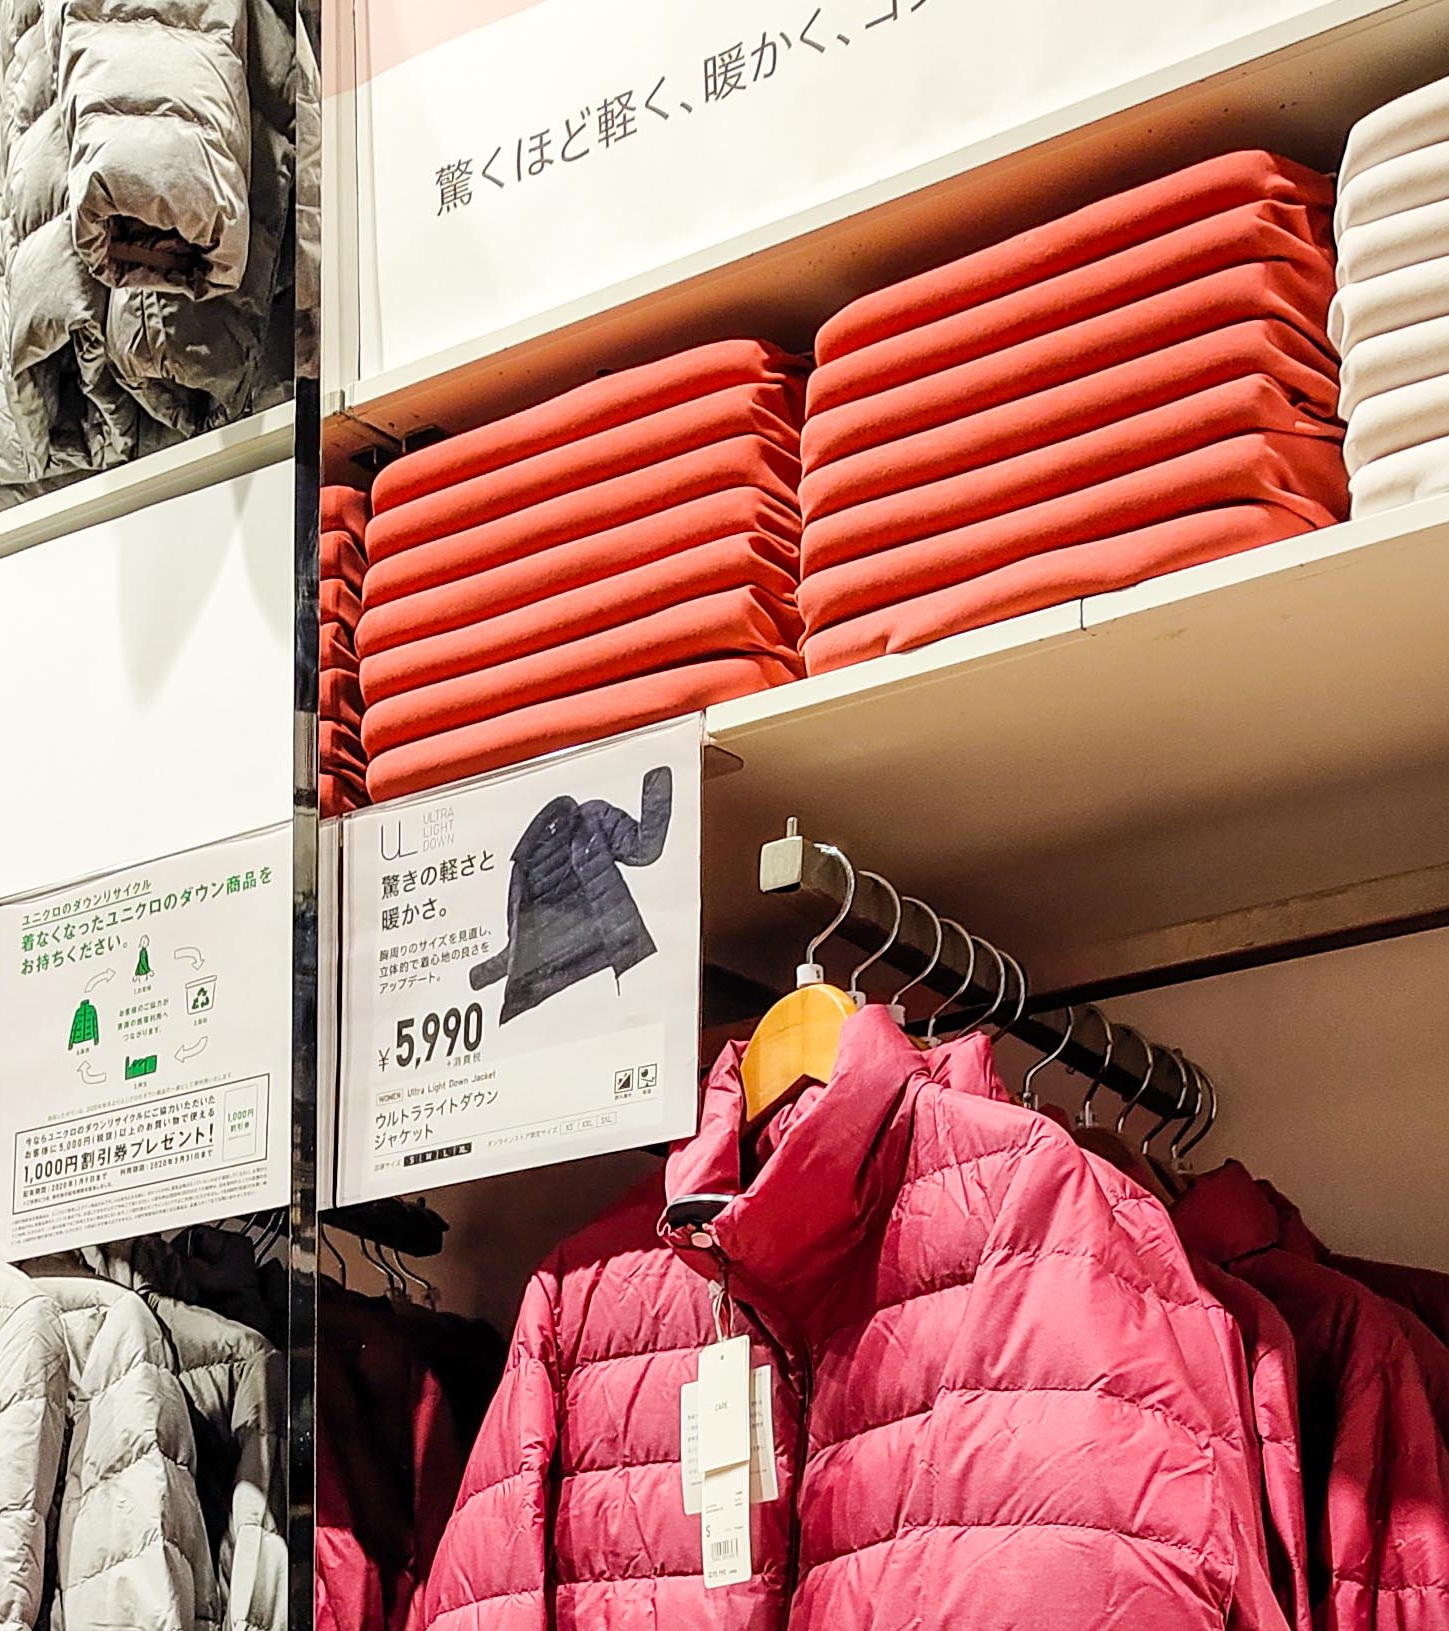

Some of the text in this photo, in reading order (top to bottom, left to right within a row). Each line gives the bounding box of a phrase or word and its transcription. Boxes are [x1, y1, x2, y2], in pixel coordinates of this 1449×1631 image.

[434, 0, 927, 217] 驚くほど軽く、暖かく、コ
[423, 807, 455, 824] ULTRA
[423, 819, 455, 838] LIGHT
[380, 820, 418, 861] UL
[423, 833, 455, 852] DOWN
[381, 850, 495, 900] 驚きの軽さと
[21, 866, 272, 952] 着なくなったユニクロのダウン商品を
[22, 879, 151, 926] ユニクロのダウンリサイクル
[381, 898, 447, 931] 暖かさ。
[21, 934, 128, 975] お持ちください。
[379, 942, 490, 978] 立体的で着心地の良さを
[407, 1086, 425, 1098] Ultra
[427, 1081, 446, 1094] Light
[449, 1077, 469, 1089] Down
[471, 1070, 496, 1083] Jacket
[375, 1091, 499, 1130] ウルトラライトダウン
[374, 1124, 434, 1151] ジャケット
